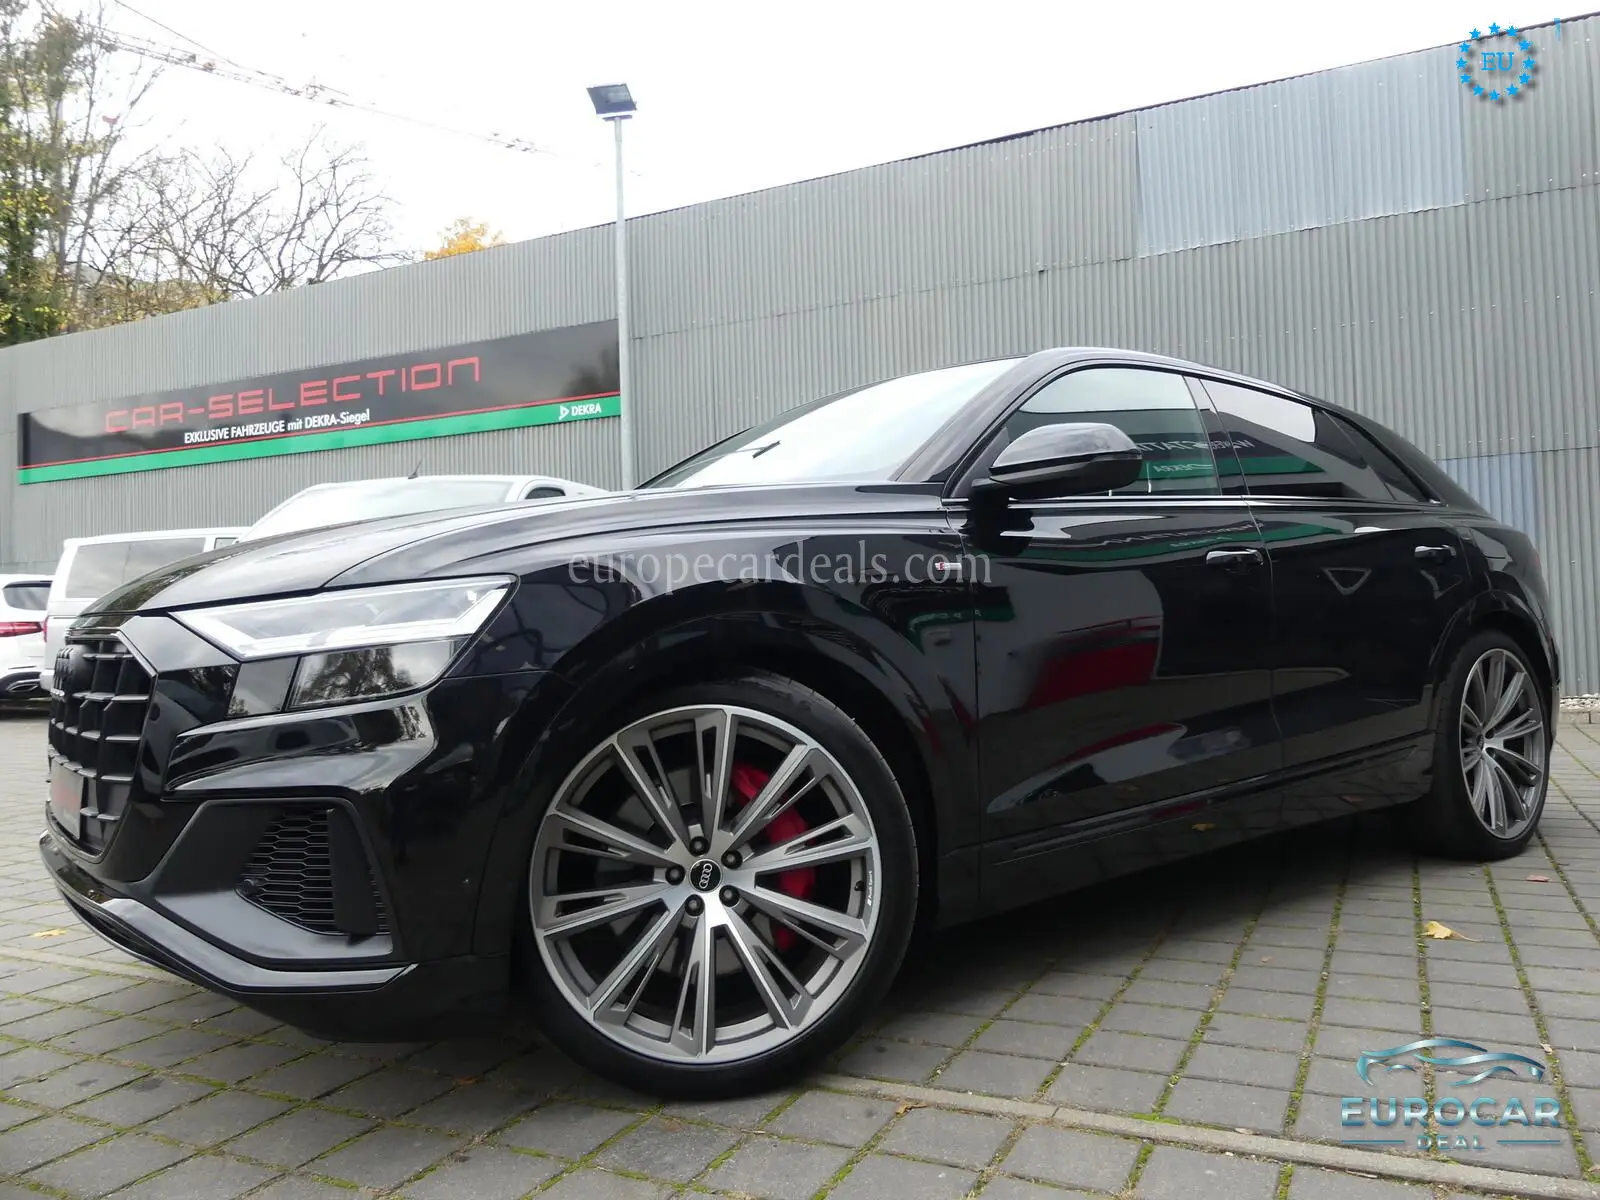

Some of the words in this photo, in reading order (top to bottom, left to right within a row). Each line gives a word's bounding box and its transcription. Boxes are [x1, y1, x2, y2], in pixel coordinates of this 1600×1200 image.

[105, 356, 481, 433] CAR-SELECTION
[571, 402, 602, 417] DEKRA
[184, 427, 230, 444] EXKLUSIVE
[230, 419, 286, 439] FAHRZEUGE
[287, 416, 304, 432] mit
[304, 408, 370, 430] DEKRA-Siegel
